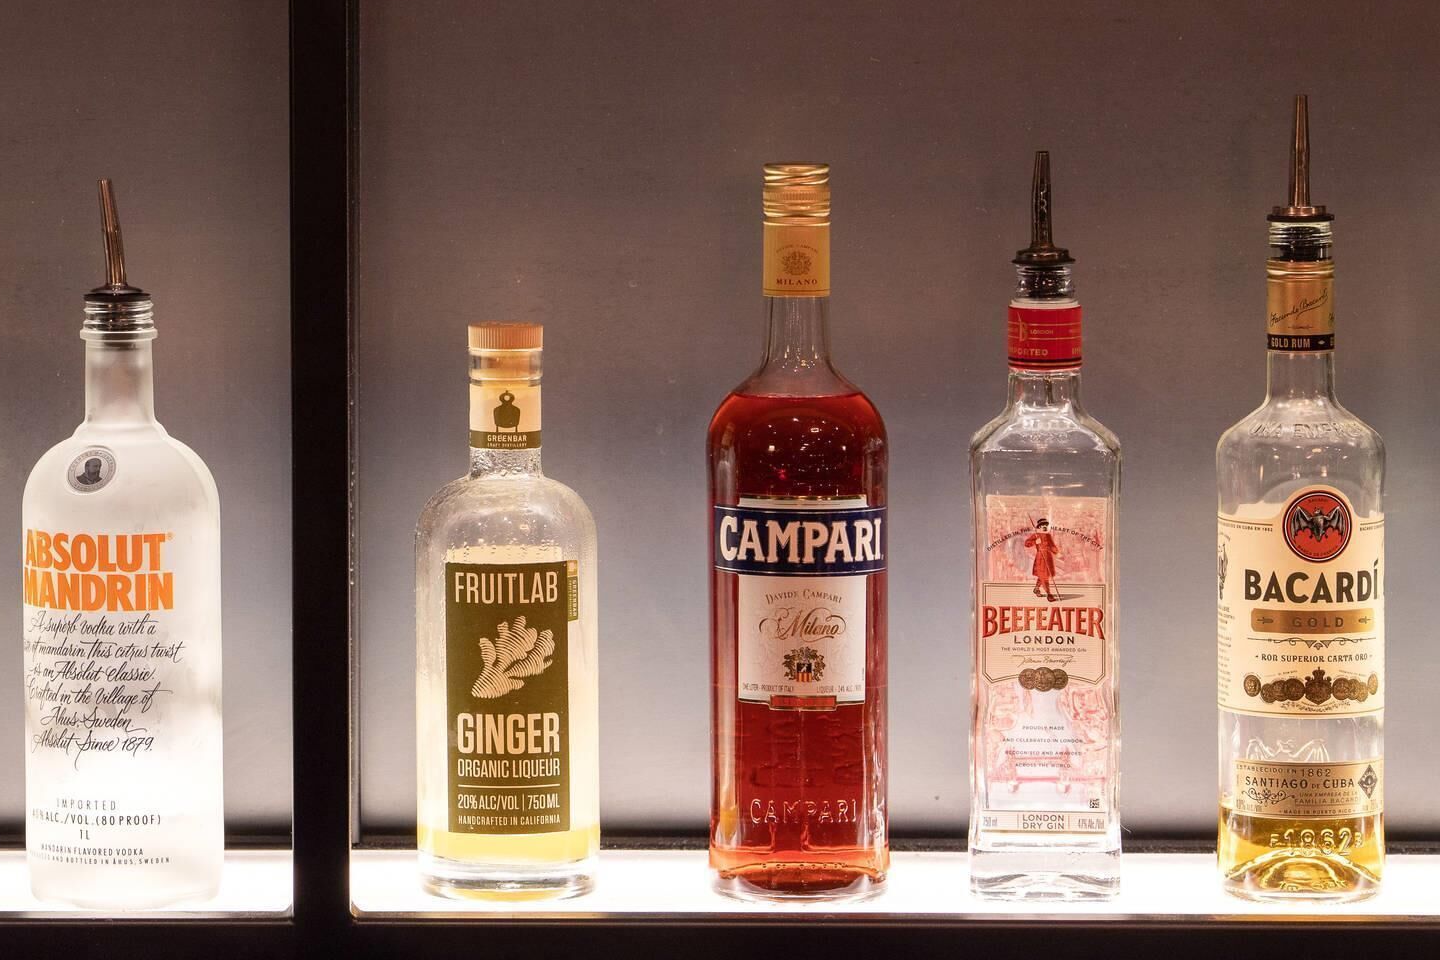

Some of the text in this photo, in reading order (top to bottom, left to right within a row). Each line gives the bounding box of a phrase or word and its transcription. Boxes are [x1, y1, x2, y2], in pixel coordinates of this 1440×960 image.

[776, 277, 818, 286] MILANO
[1271, 337, 1310, 349] GOLD RUM
[486, 435, 528, 443] GREENBAR
[719, 515, 881, 565] CAMPARI
[25, 528, 166, 573] ABSOLUT
[454, 571, 559, 604] FRUITLAB
[1244, 559, 1379, 604] BACARDÍ
[24, 567, 174, 612] MANDRIN
[765, 588, 842, 606] DAVIDE CAMPARI
[759, 606, 847, 644] Milano
[982, 605, 1106, 641] BEEFEATER
[1292, 616, 1344, 629] GOLD
[1013, 635, 1075, 645] LONDON
[1261, 652, 1368, 663] RON SUPERIOR CARTA ORO
[457, 712, 560, 755] GINGER
[457, 757, 560, 779] ORGANIC LIQUEUR
[1245, 775, 1309, 789] SANTIAGO
[1322, 778, 1355, 789] CUBA
[56, 797, 117, 811] IMPORTED
[457, 793, 560, 810] 20% ALC/VOL 750 ML
[458, 815, 561, 826] HANDCRAFTED IN CALIFORNIA
[1022, 814, 1065, 822] LONDON
[1022, 822, 1065, 830] DRY GIN
[73, 844, 145, 856] FLAVORED VODKA
